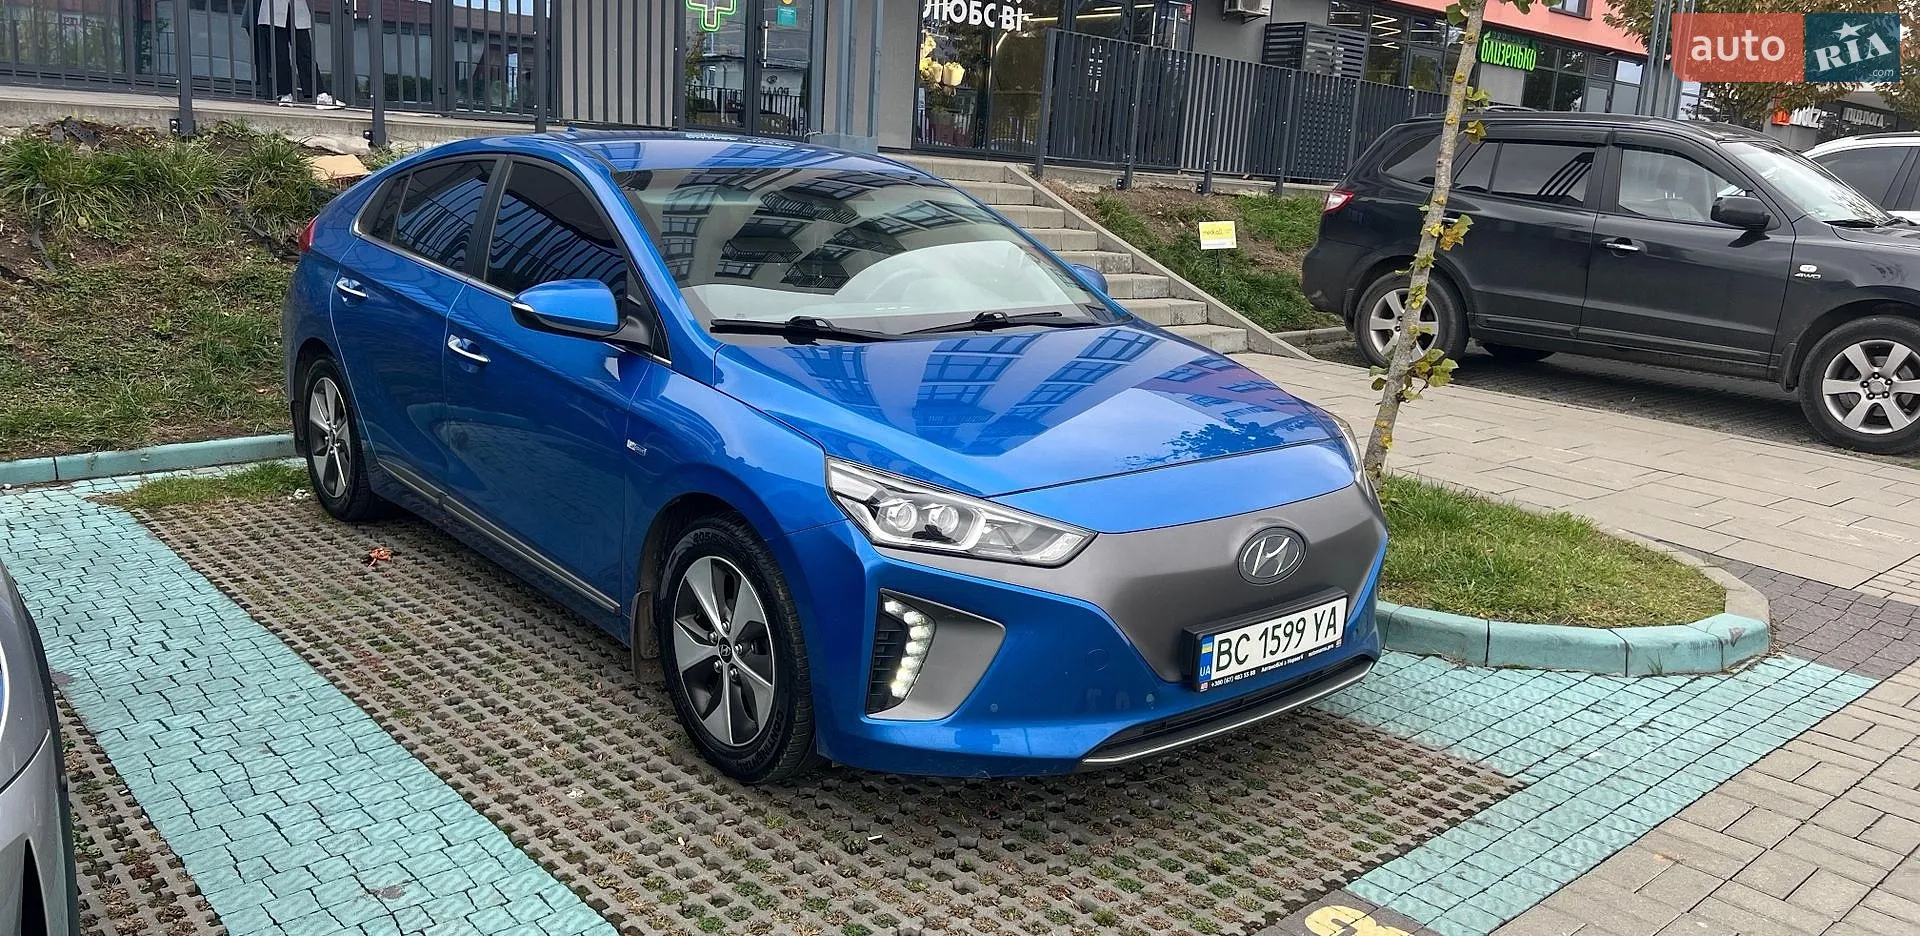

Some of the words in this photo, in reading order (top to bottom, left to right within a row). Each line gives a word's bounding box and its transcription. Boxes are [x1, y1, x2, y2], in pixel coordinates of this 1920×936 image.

[1480, 31, 1537, 71] близенько
[1215, 632, 1250, 672] BC
[1258, 617, 1307, 659] 1599
[1313, 605, 1337, 642] YA
[1200, 664, 1211, 677] UA
